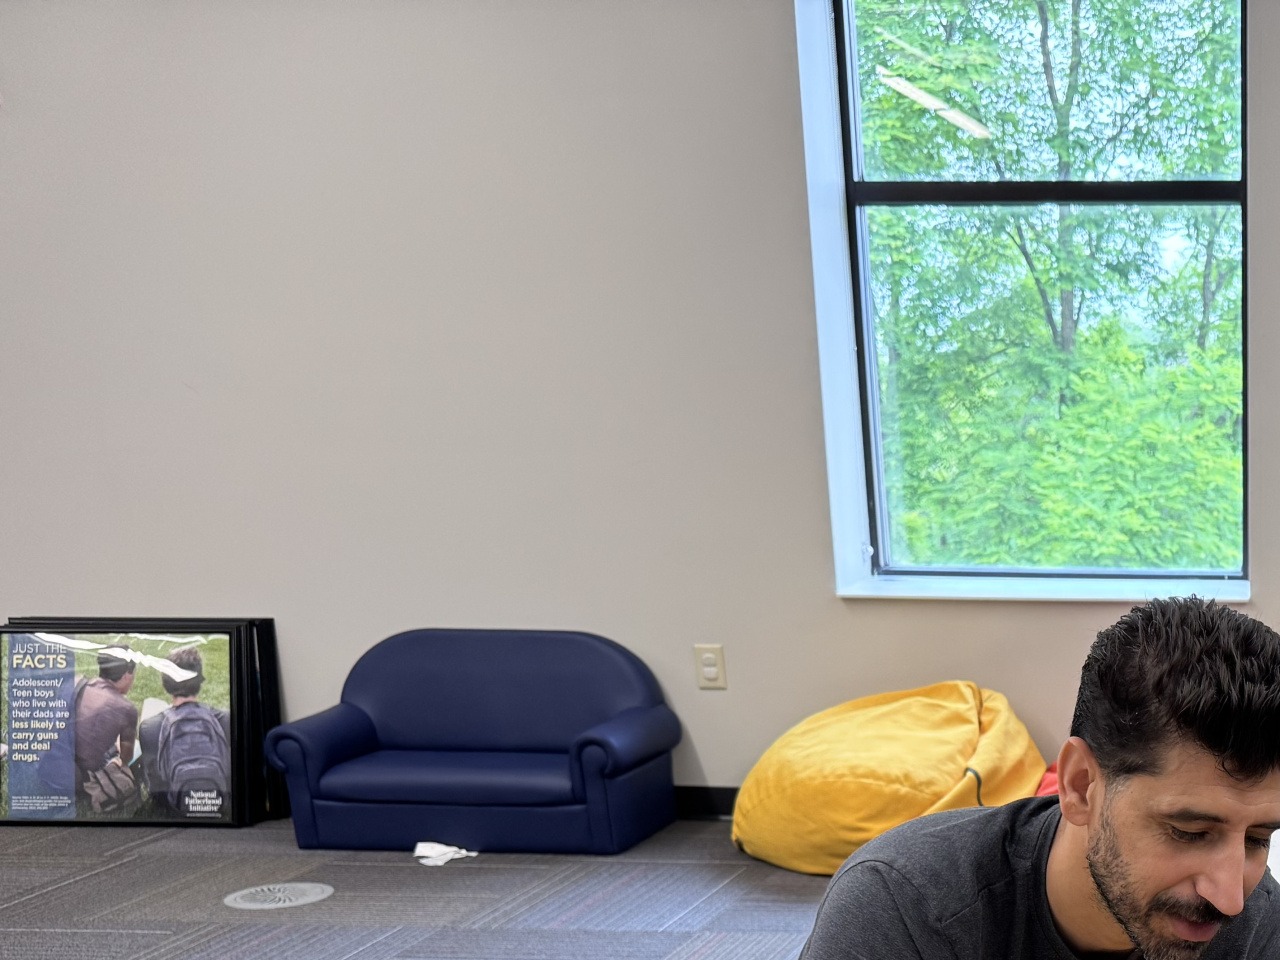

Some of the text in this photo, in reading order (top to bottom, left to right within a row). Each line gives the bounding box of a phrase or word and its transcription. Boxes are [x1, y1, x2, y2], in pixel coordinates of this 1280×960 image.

[12, 643, 67, 654] JUST THE
[12, 654, 67, 669] FACTS
[12, 678, 64, 688] Adolescent/
[12, 688, 54, 699] Teen boys
[12, 699, 67, 708] who live with
[12, 709, 31, 718] their
[33, 709, 54, 718] dads
[12, 720, 66, 731] less likely to
[12, 732, 58, 741] carry guns
[12, 742, 50, 750] and deal
[12, 752, 40, 762] drugs.
